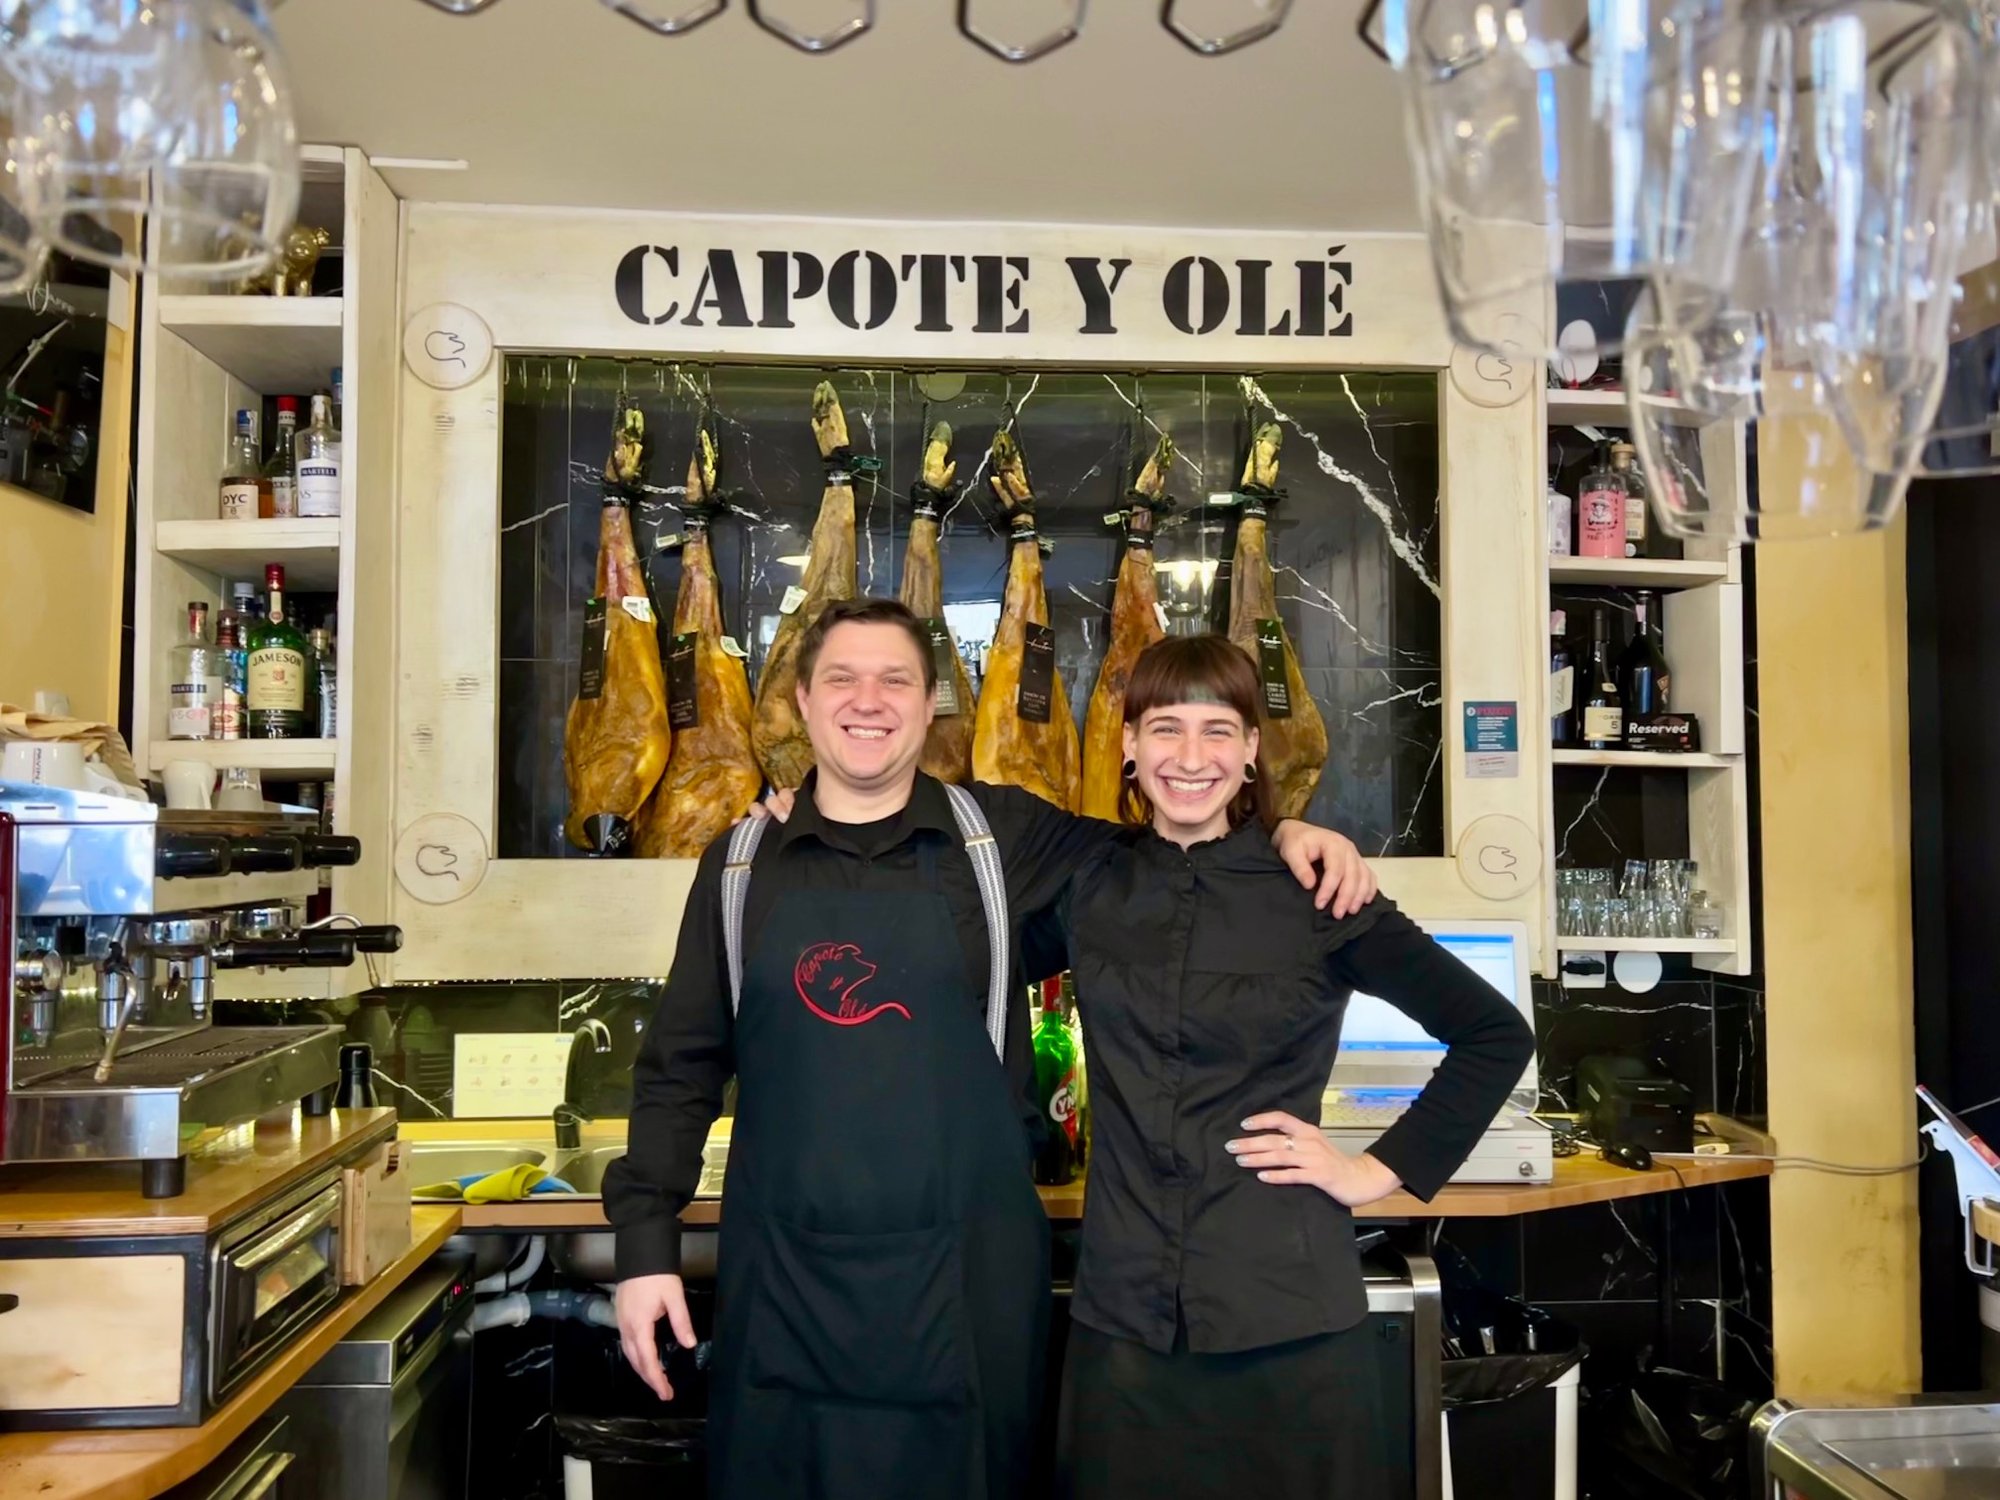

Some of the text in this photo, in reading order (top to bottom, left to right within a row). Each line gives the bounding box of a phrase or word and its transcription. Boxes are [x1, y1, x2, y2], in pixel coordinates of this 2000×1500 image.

[614, 243, 1354, 337] CAPOTE Y OLÉ
[301, 467, 336, 477] MARTELL
[223, 493, 248, 506] DYC
[252, 652, 304, 667] JAMESON
[1628, 721, 1690, 735] Reserved
[801, 947, 844, 984] Capote
